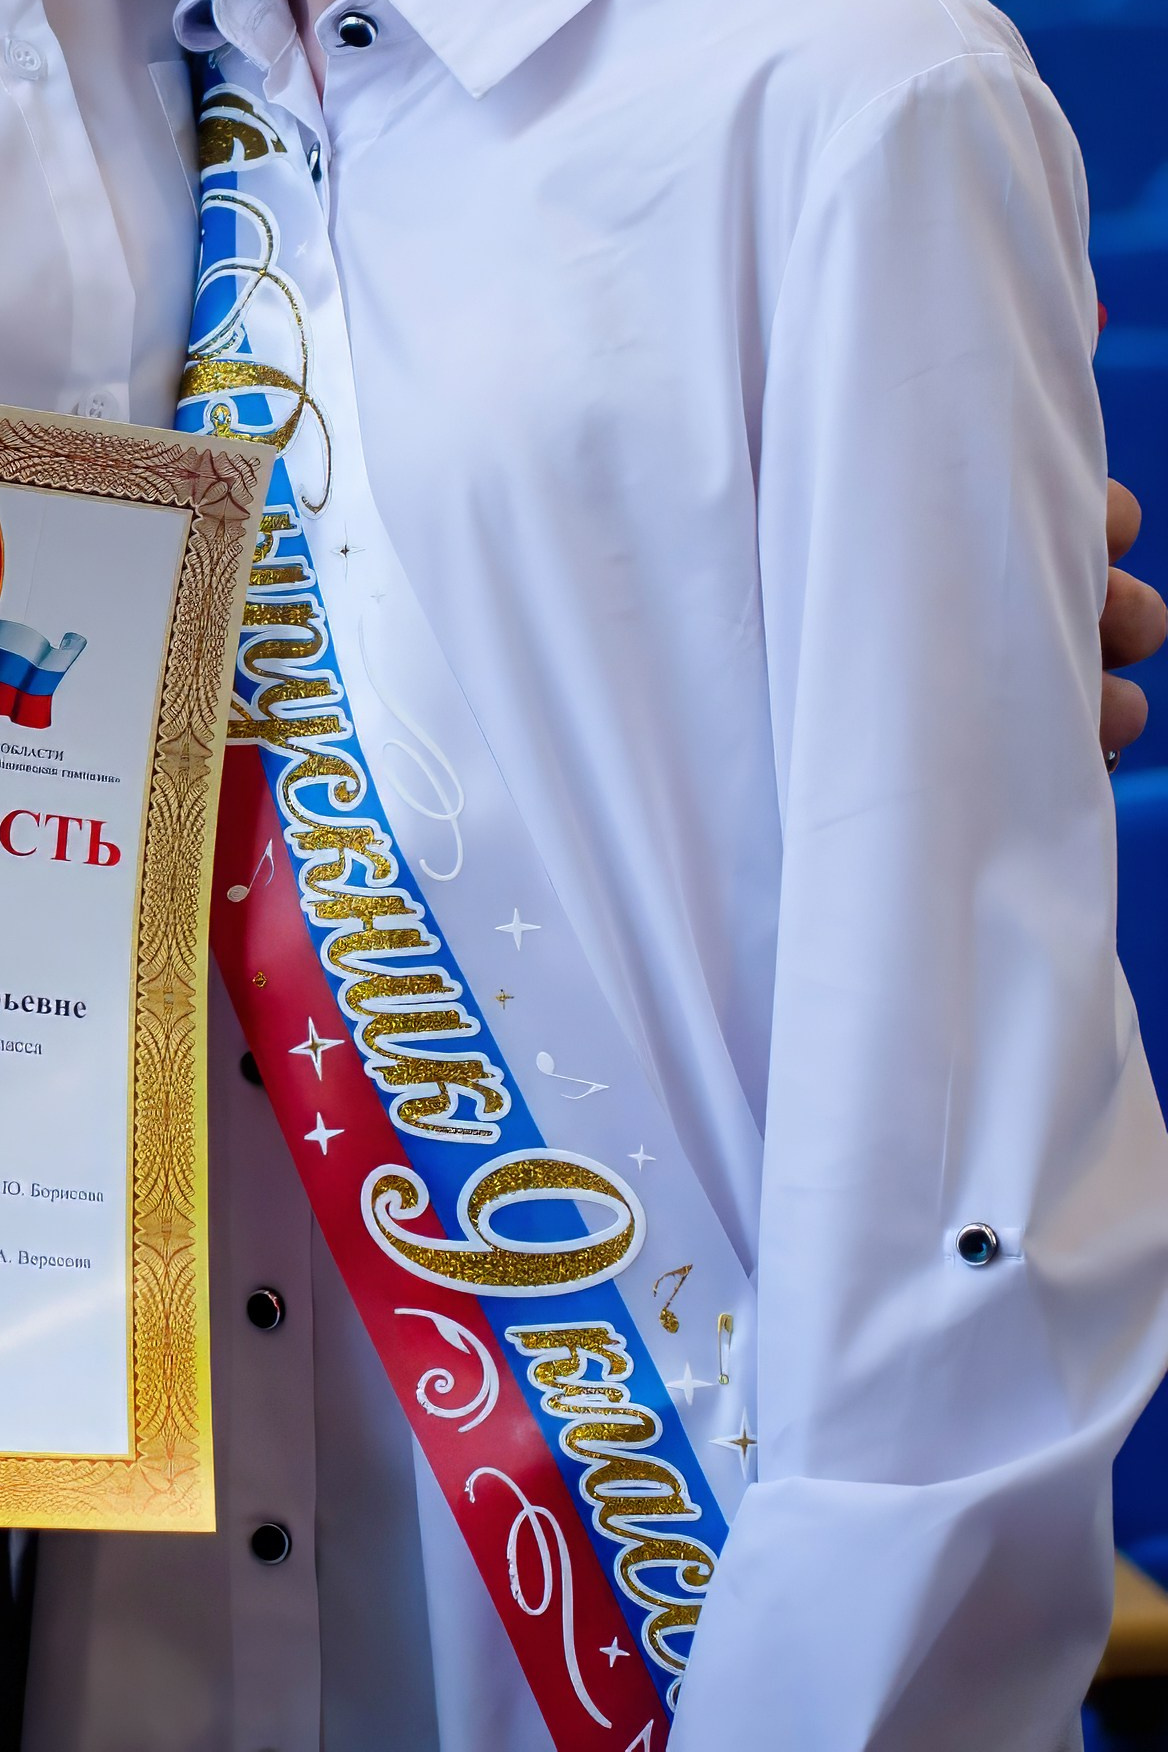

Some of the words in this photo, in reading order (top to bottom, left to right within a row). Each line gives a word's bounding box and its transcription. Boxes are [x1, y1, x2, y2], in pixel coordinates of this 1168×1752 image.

[0, 743, 64, 762] ОБЛАСТИ
[2, 1180, 25, 1197] Ю.
[30, 1182, 105, 1204] Борисова
[360, 1147, 646, 1298] 9
